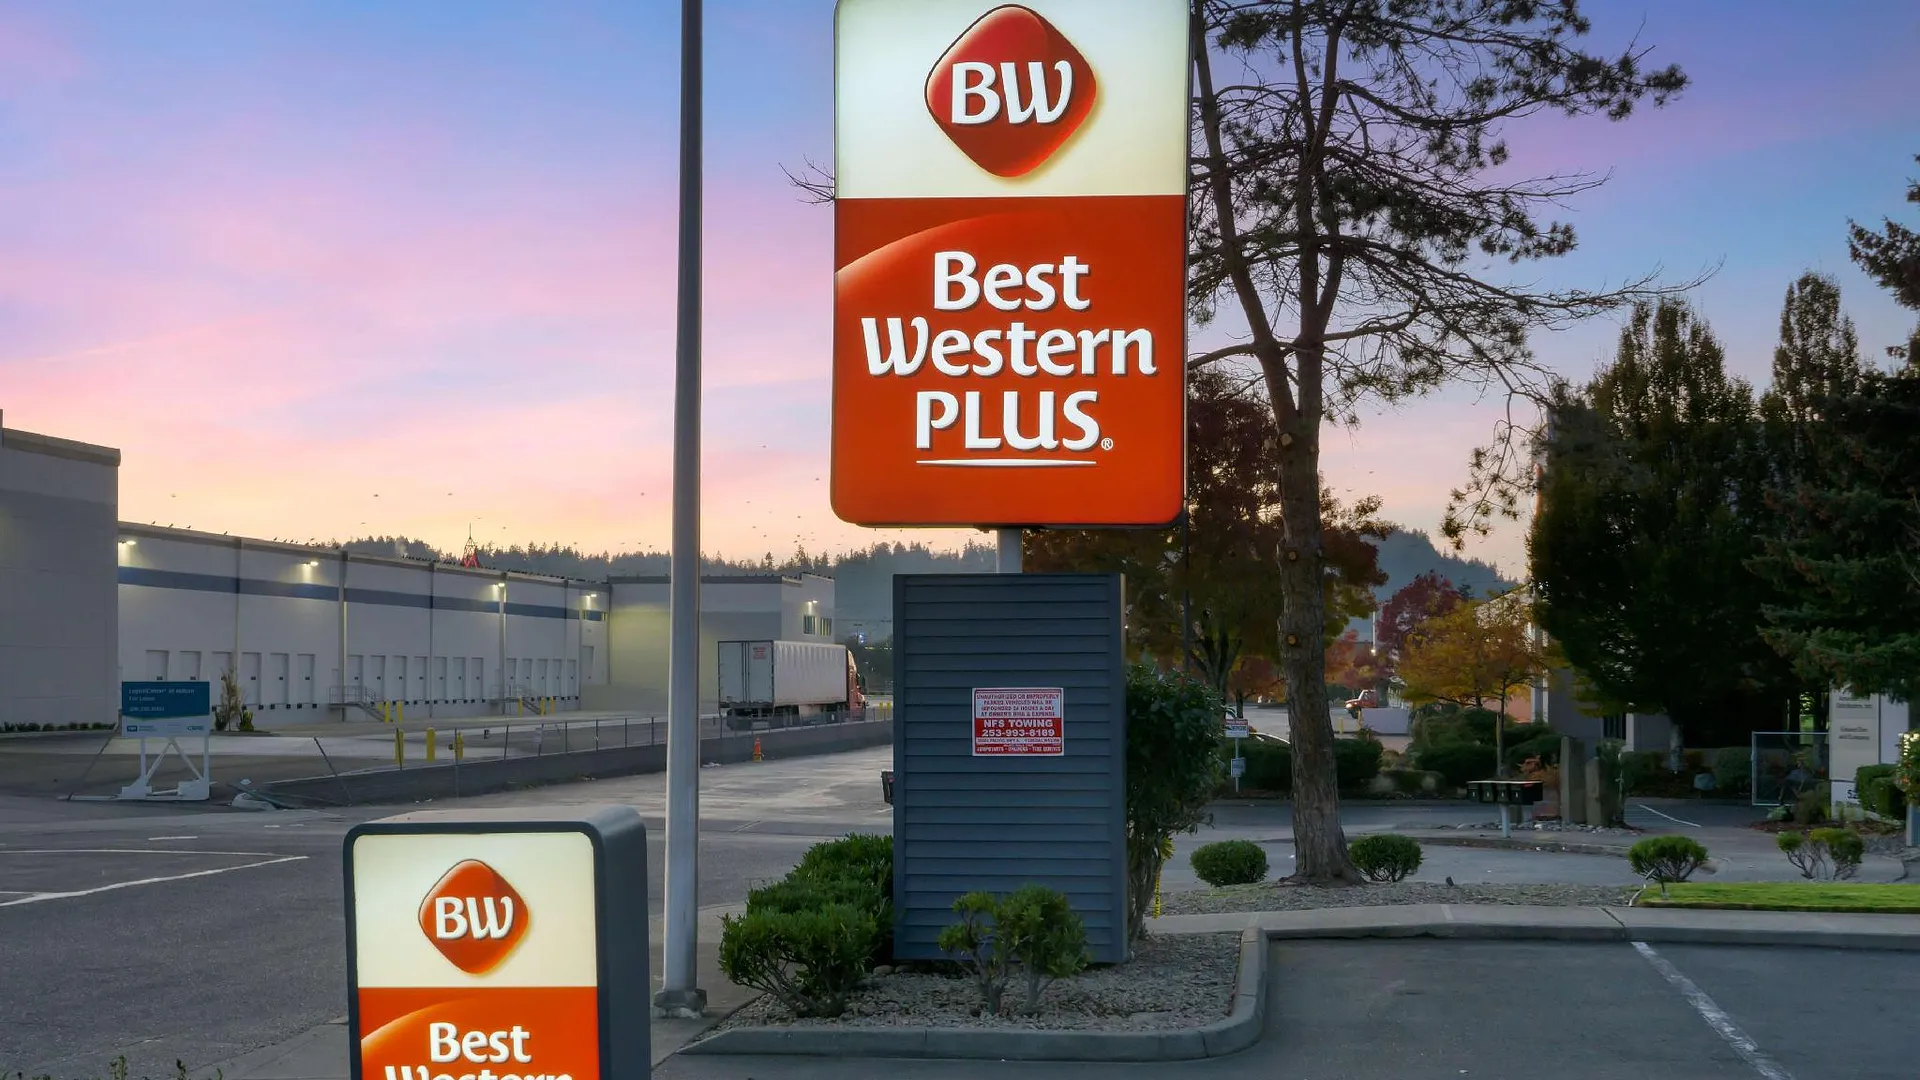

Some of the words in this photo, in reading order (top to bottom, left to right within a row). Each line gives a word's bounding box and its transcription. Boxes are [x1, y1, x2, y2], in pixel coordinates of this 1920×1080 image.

[951, 60, 1073, 124] BW
[933, 251, 1091, 311] Best
[861, 316, 1157, 376] Western
[983, 719, 1005, 728] NFS
[1008, 719, 1053, 728] TOWING
[435, 896, 514, 939] BW
[429, 1022, 532, 1063] Best
